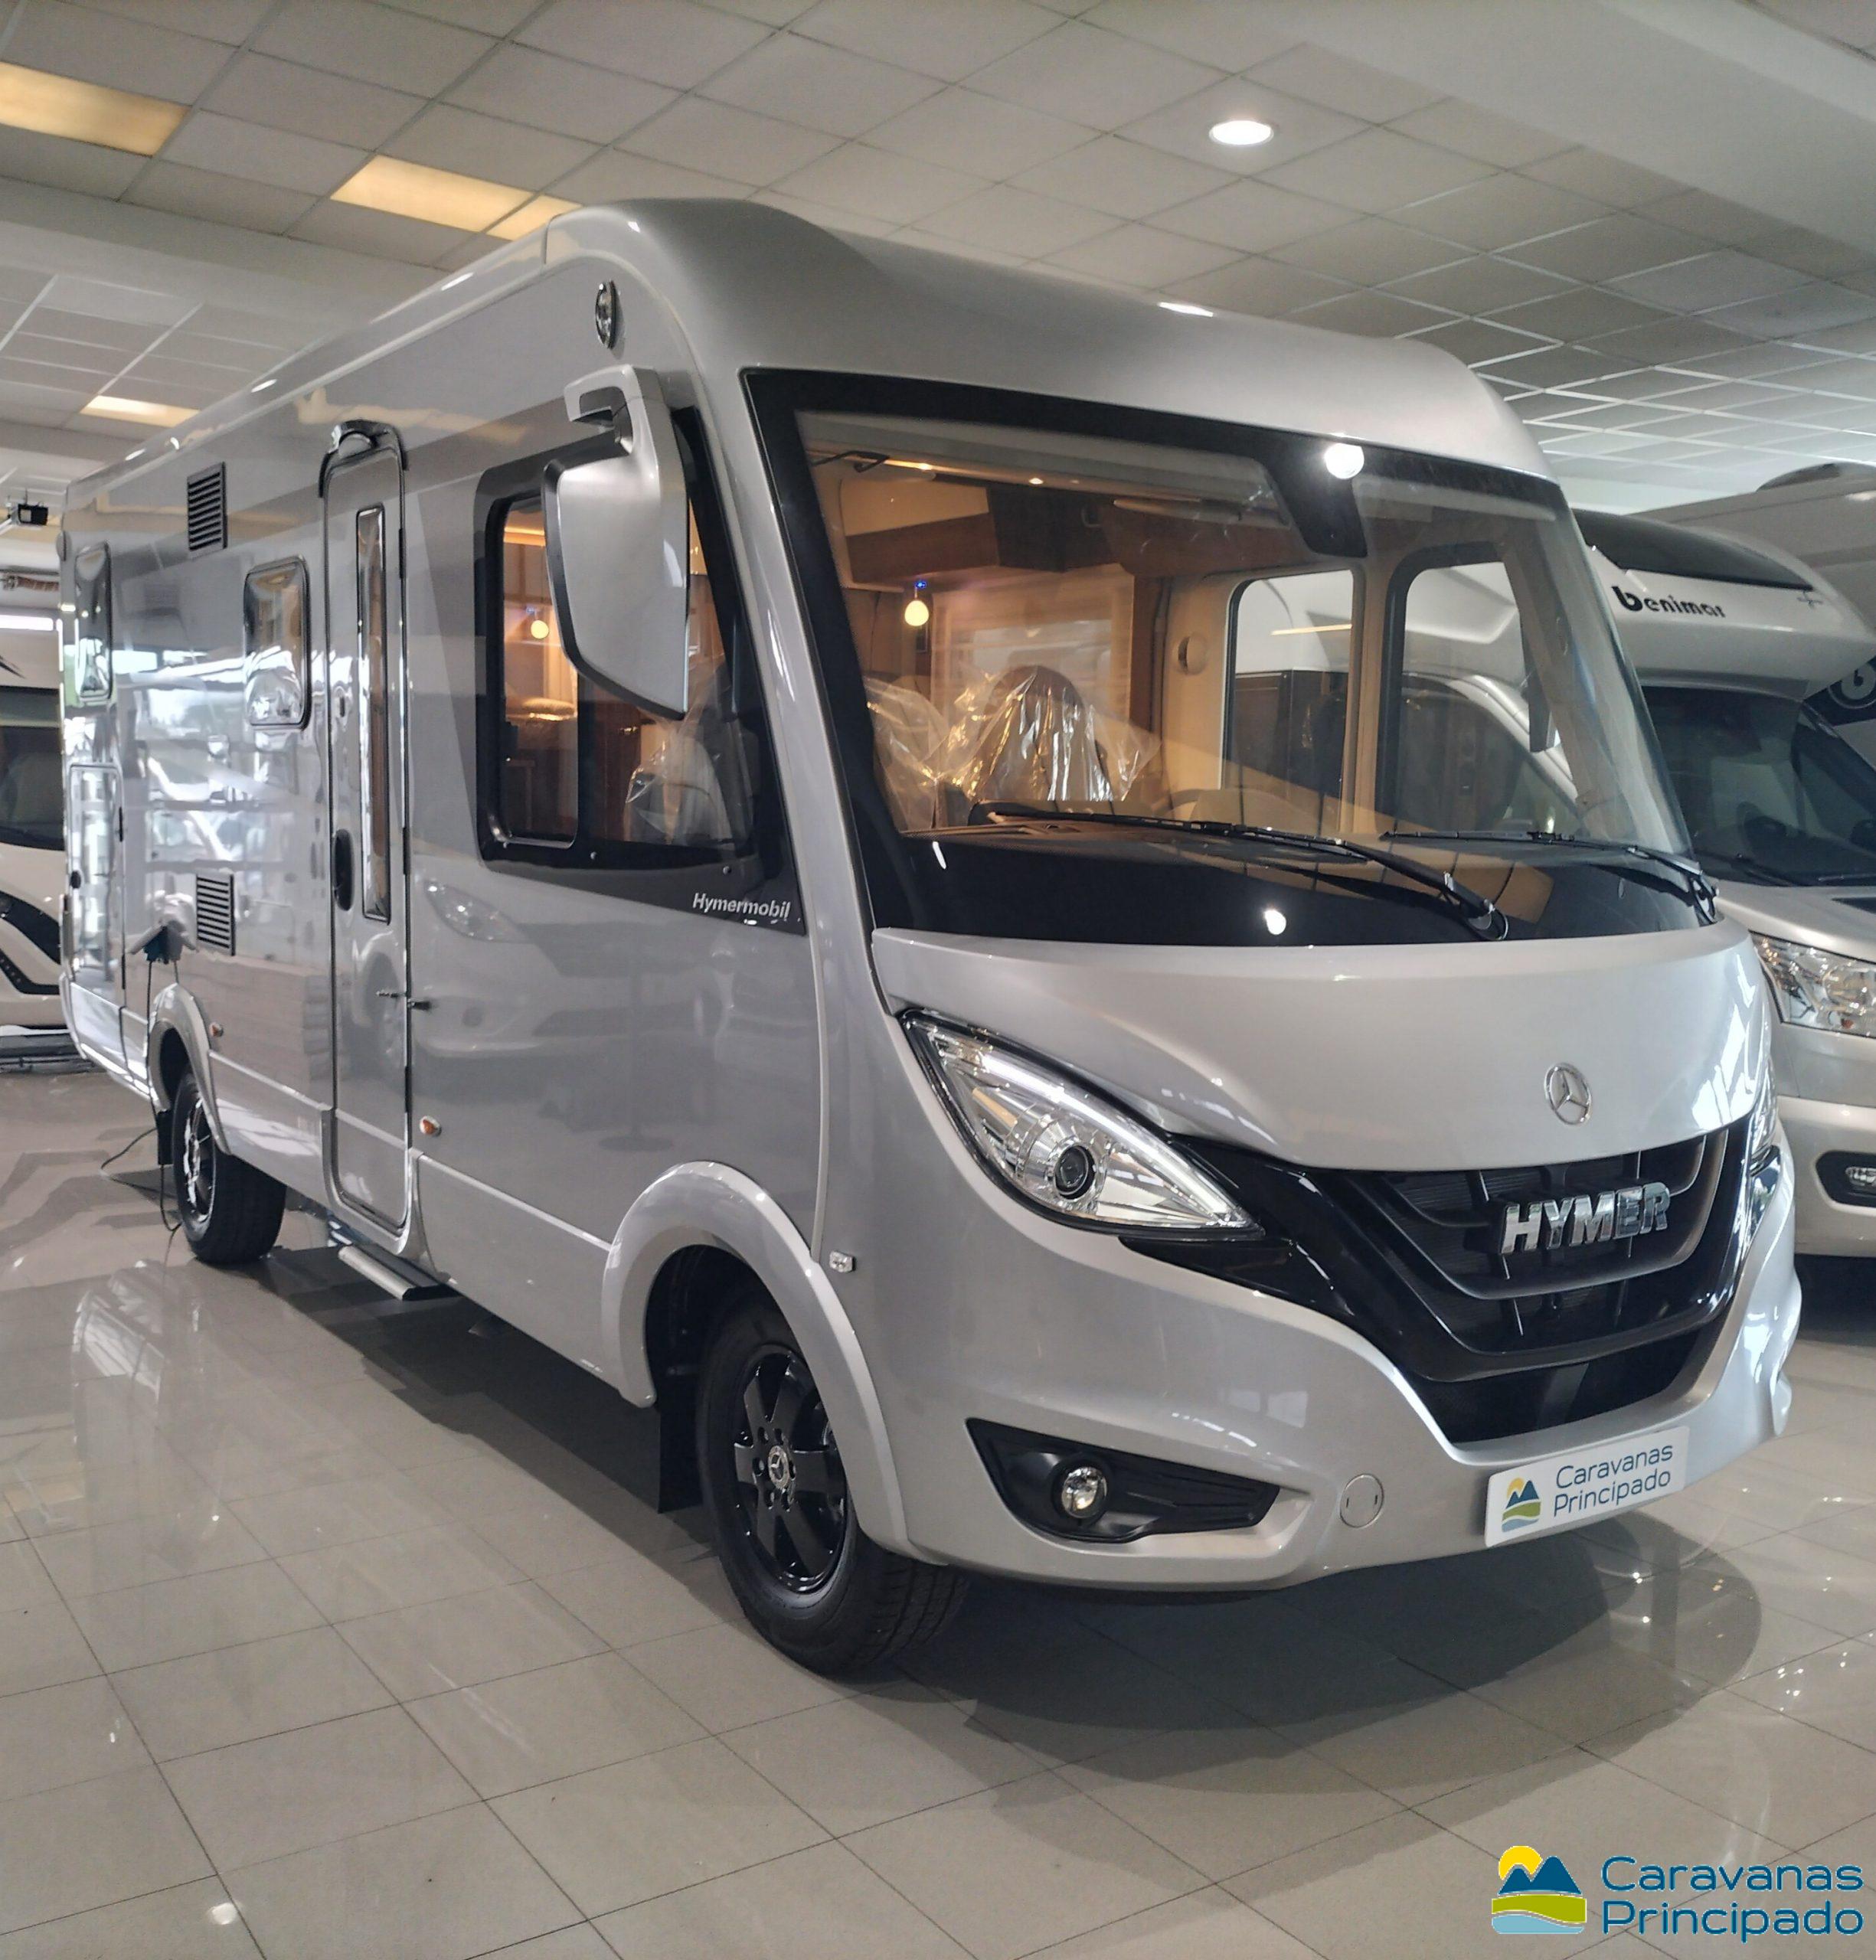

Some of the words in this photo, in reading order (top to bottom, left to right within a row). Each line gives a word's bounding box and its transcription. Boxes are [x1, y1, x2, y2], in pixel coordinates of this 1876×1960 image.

[1612, 586, 1726, 618] benimar
[692, 892, 791, 920] Hymermobil
[1499, 1181, 1671, 1255] HYMER
[1556, 1445, 1674, 1489] Caravanas
[1553, 1469, 1671, 1517] Principado
